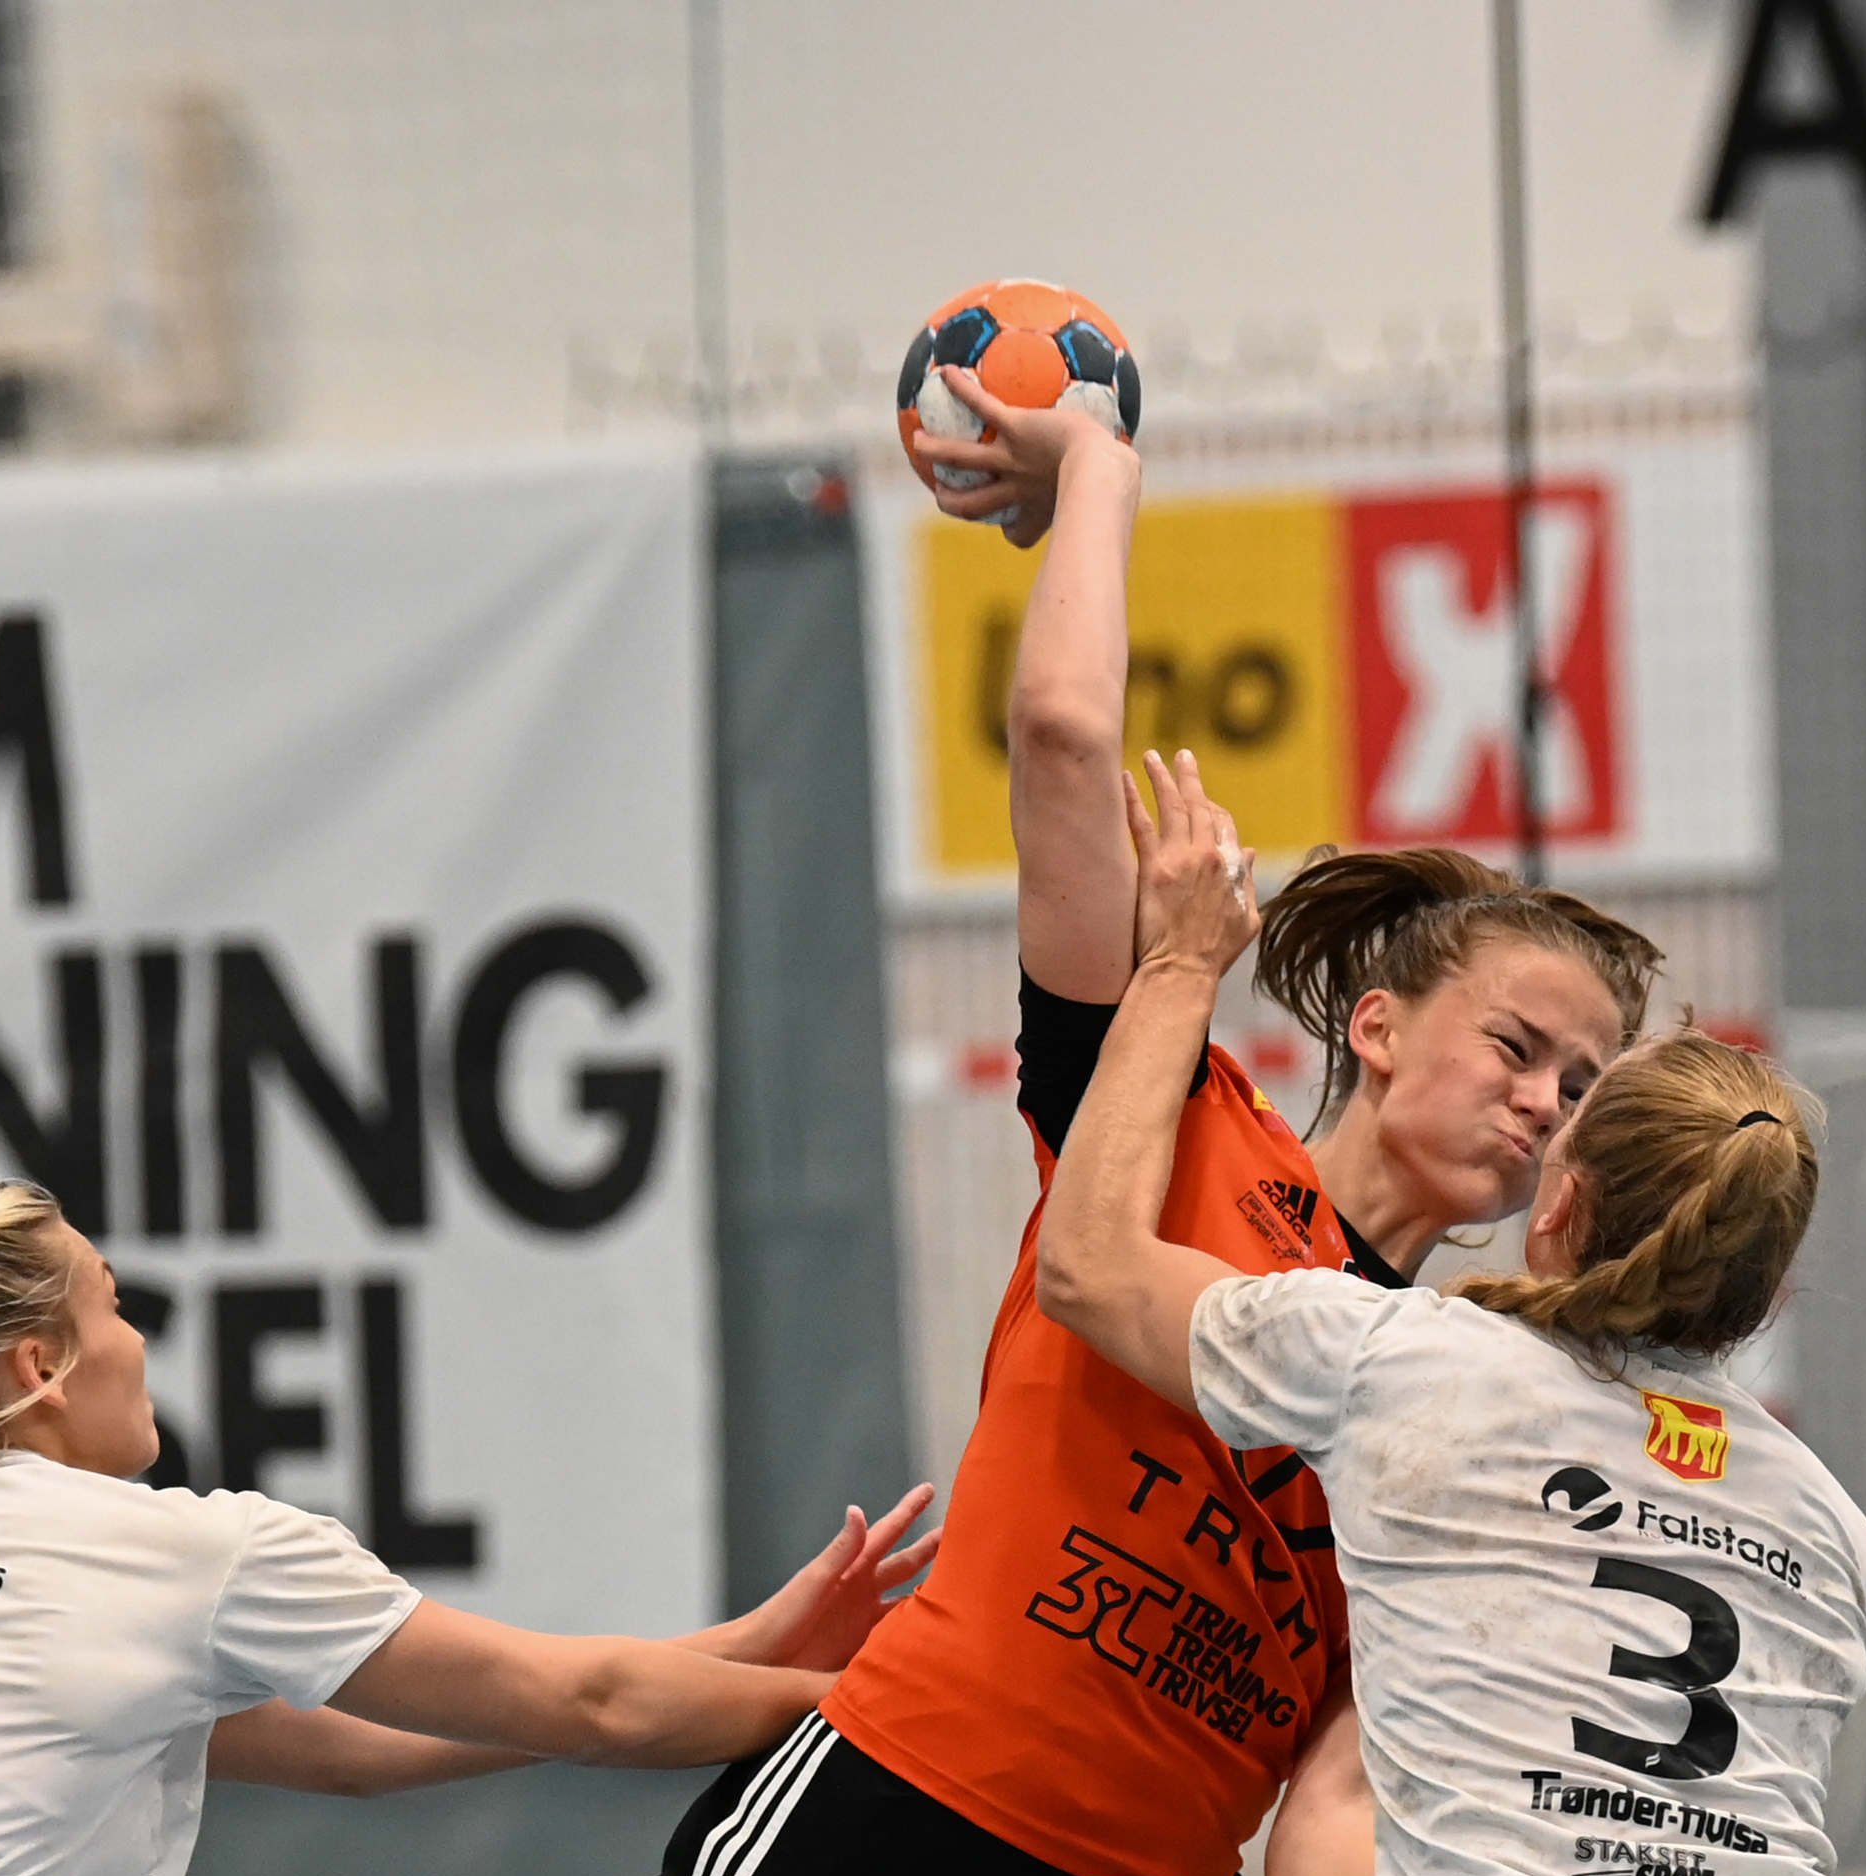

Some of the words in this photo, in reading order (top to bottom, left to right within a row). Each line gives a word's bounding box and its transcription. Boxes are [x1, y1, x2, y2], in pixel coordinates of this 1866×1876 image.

[1258, 1179, 1313, 1248] adidas
[1636, 1500, 1803, 1590] Falstads
[1180, 1592, 1262, 1664] TRIM
[1571, 1556, 1742, 1781] 3
[1145, 1653, 1254, 1744] TRIVSEL
[1162, 1622, 1297, 1728] TRENING
